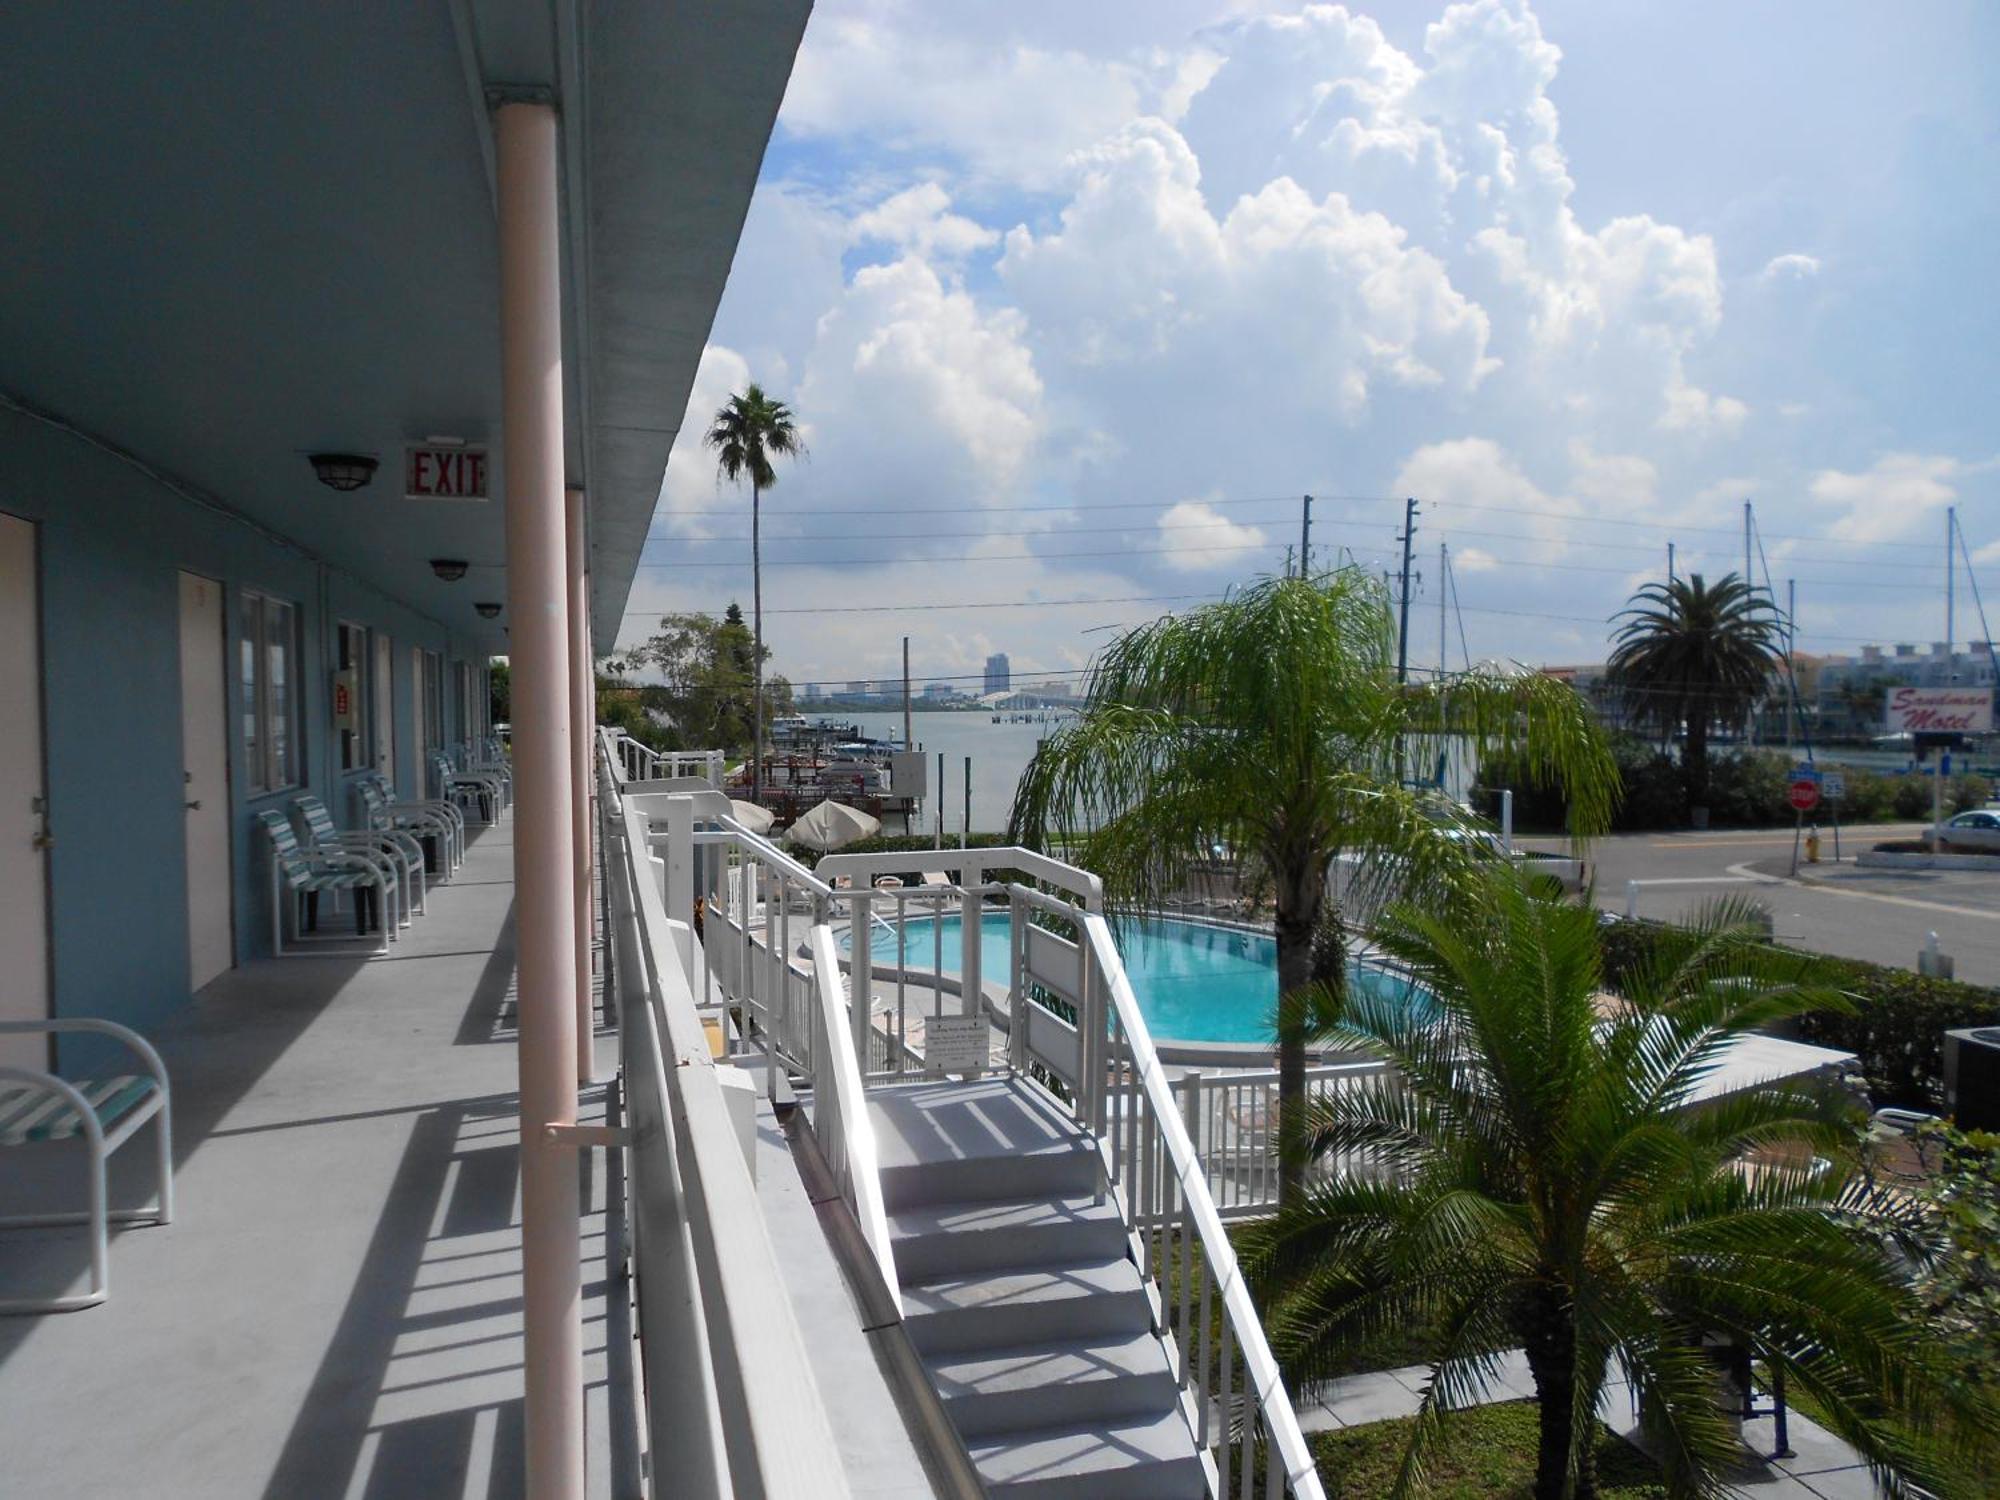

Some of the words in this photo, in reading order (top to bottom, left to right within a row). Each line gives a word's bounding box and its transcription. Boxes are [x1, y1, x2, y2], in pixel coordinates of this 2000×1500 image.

[415, 452, 484, 495] EXIT
[1891, 689, 1988, 710] Sandman
[1903, 707, 1977, 728] Motel
[1791, 789, 1815, 800] STOP
